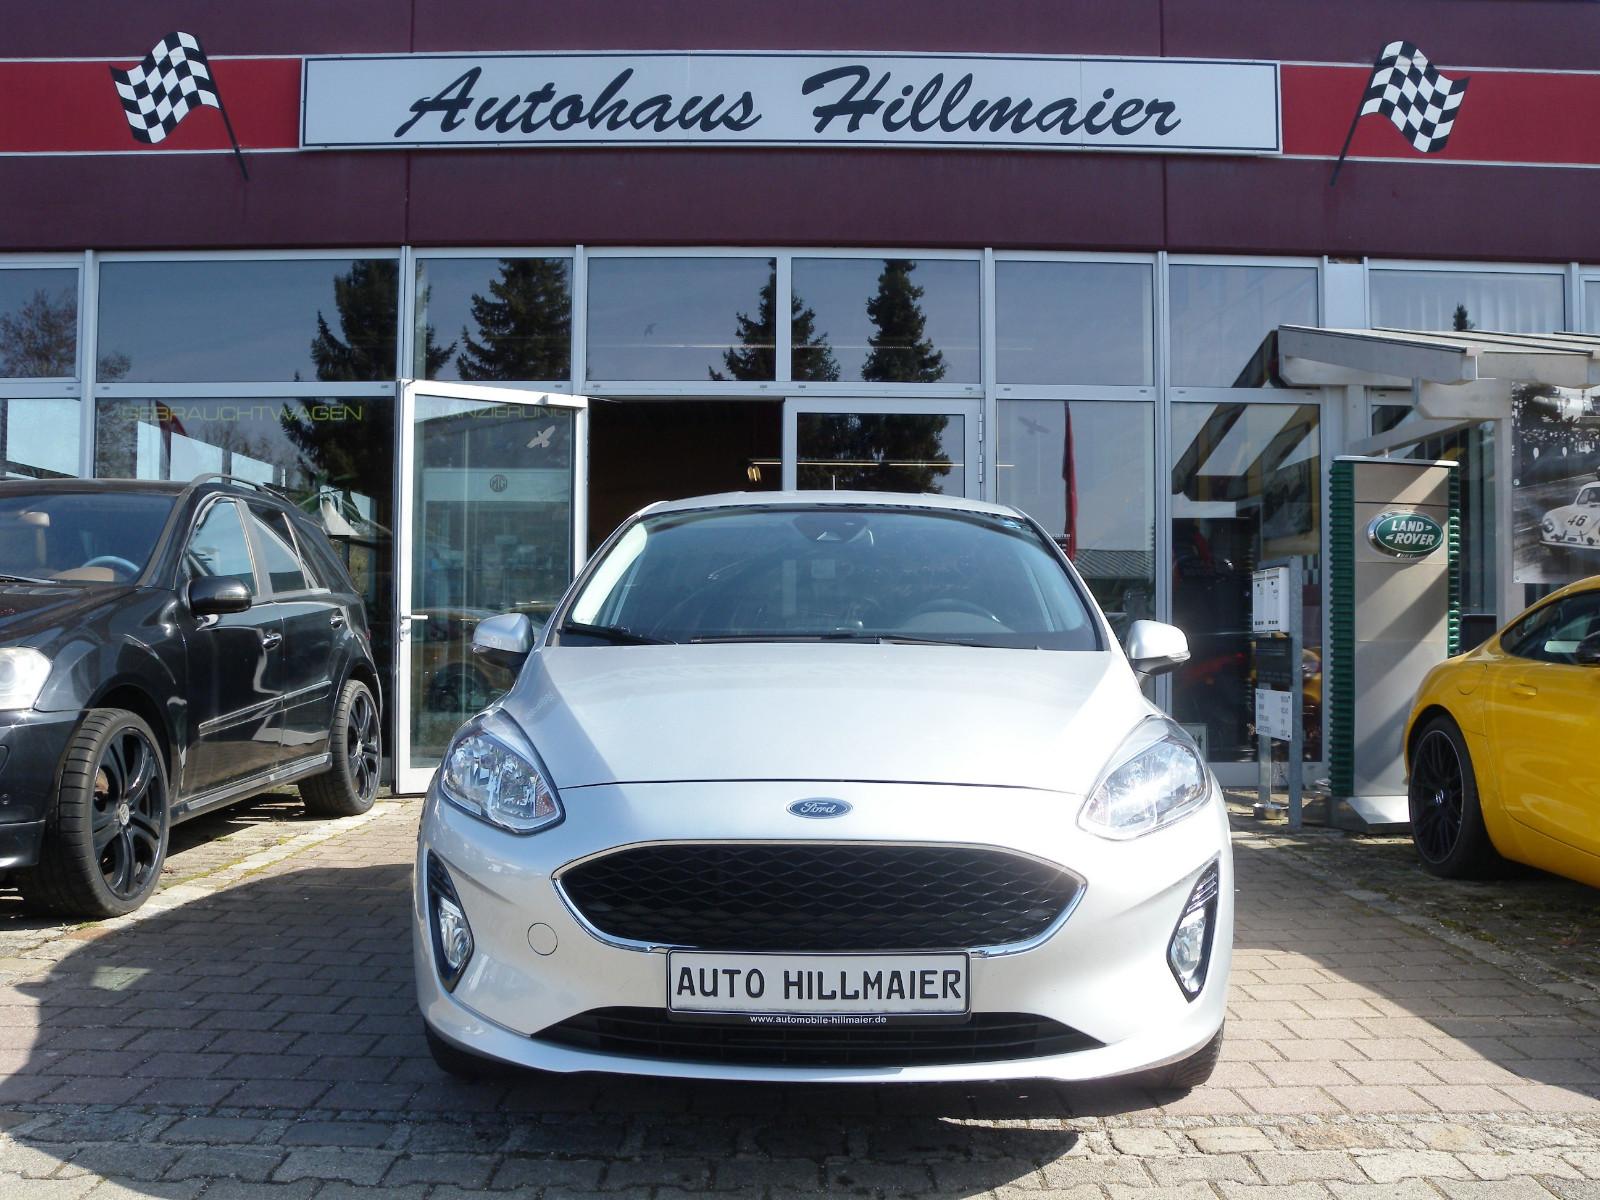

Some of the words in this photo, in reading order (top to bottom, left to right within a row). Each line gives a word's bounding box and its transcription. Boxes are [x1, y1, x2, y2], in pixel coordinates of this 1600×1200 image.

[394, 66, 762, 138] Autohaus
[801, 64, 1181, 136] Hillmaier
[121, 405, 363, 421] GEBRAUCHTWAGEN
[1391, 520, 1425, 532] LAND
[1567, 514, 1588, 527] 46
[1394, 532, 1435, 546] ROVER
[800, 802, 837, 813] Ford
[676, 966, 765, 998] AUTO
[783, 969, 962, 1001] HILLMAIER
[749, 1015, 887, 1024] www.automobile-hillmaier.de
